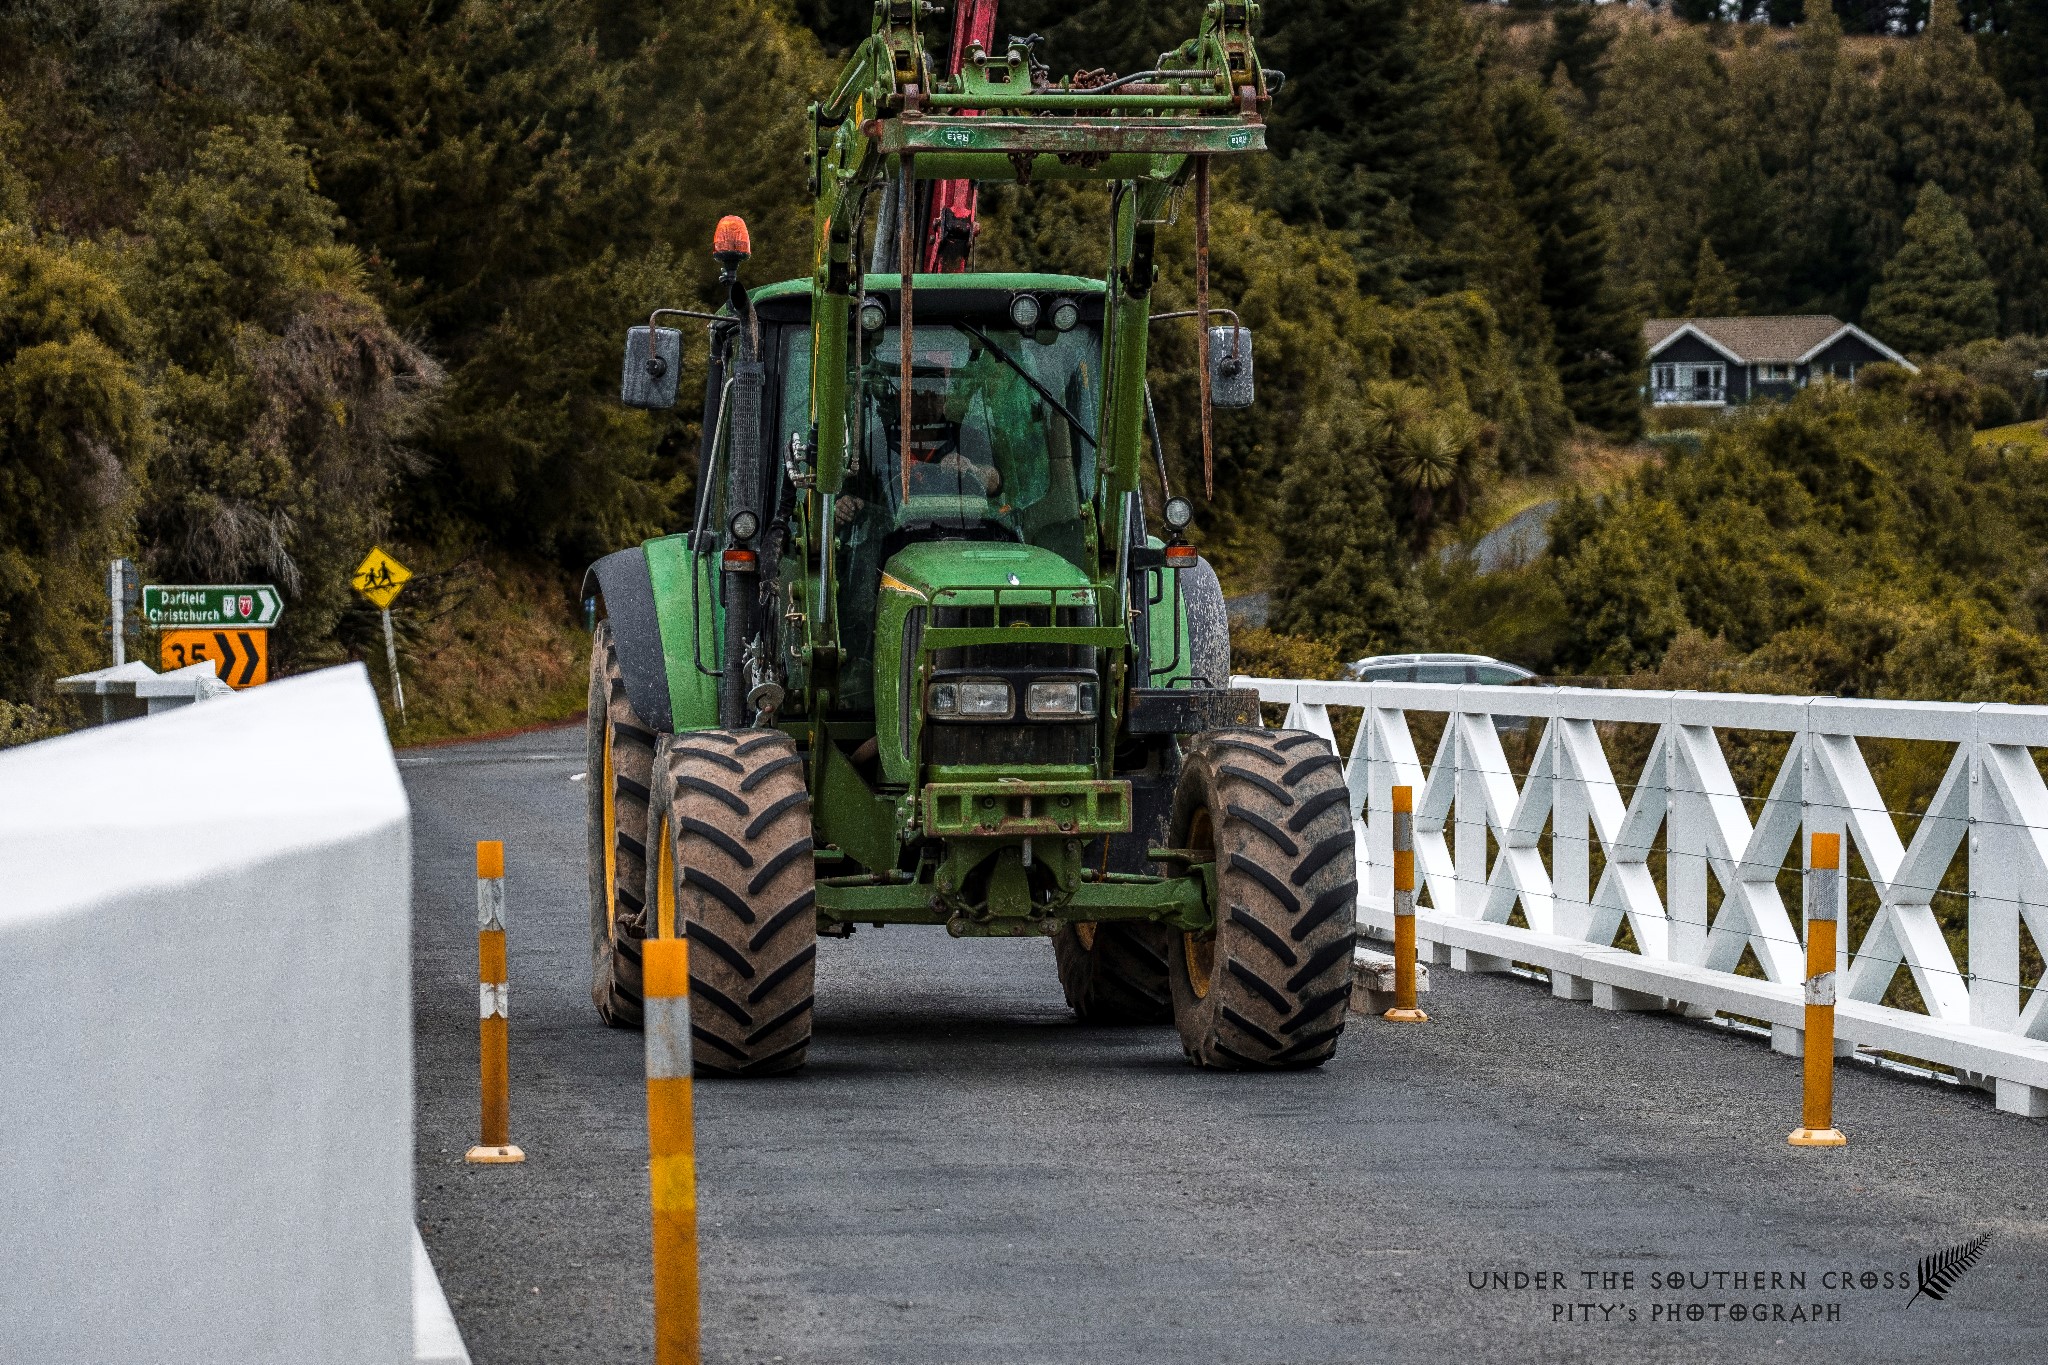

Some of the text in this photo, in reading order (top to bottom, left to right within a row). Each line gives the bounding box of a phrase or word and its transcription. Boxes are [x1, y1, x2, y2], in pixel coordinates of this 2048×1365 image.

[161, 591, 206, 606] Darfield
[239, 599, 251, 609] 77
[149, 608, 220, 623] Christchurch
